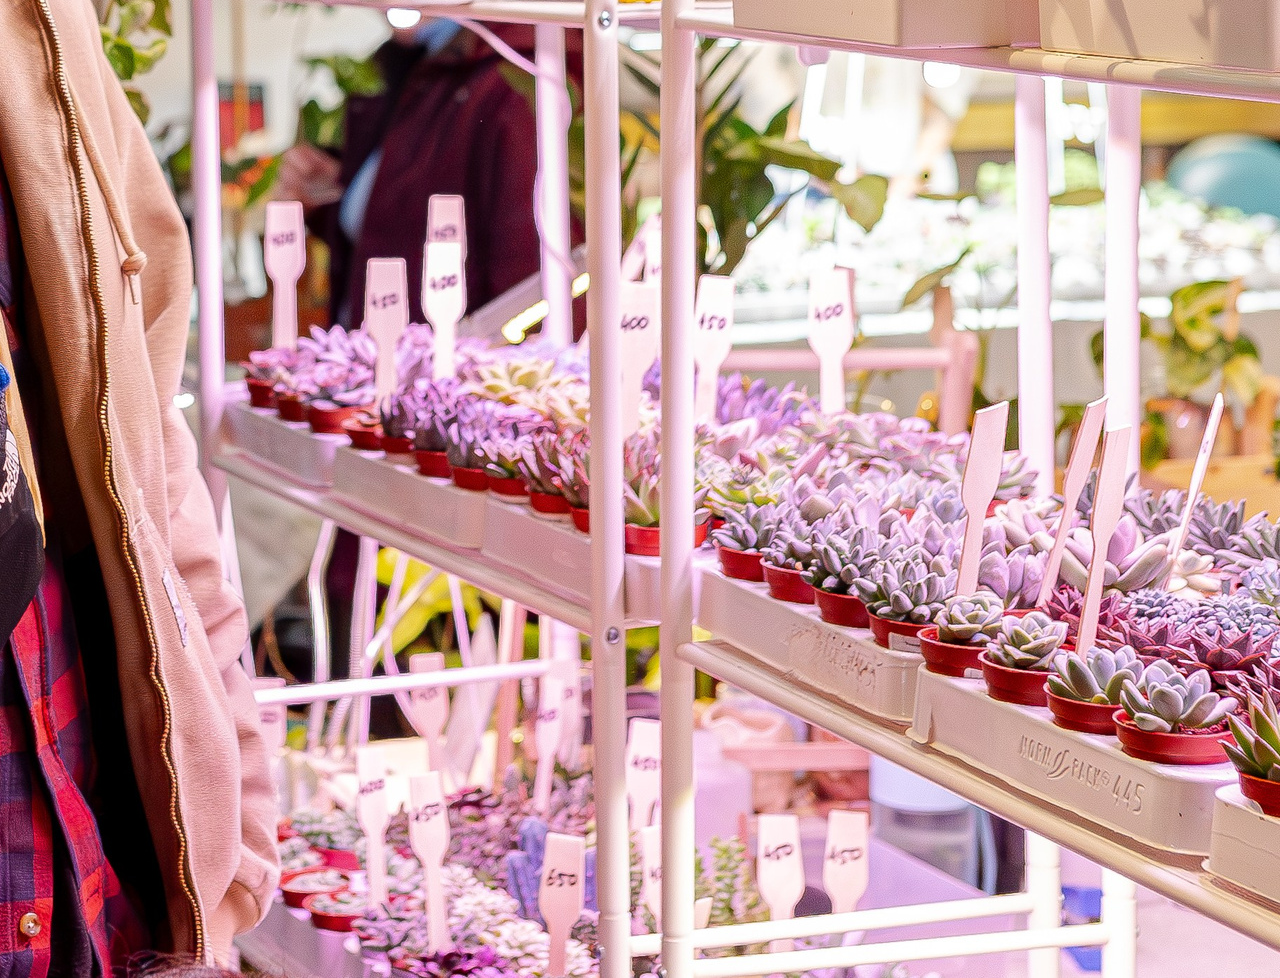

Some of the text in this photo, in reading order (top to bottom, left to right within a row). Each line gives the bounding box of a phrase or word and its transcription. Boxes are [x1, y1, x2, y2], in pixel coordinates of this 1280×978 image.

[620, 313, 649, 333] 400
[813, 304, 843, 322] 400
[1112, 774, 1146, 815] 445
[546, 868, 578, 889] 650
